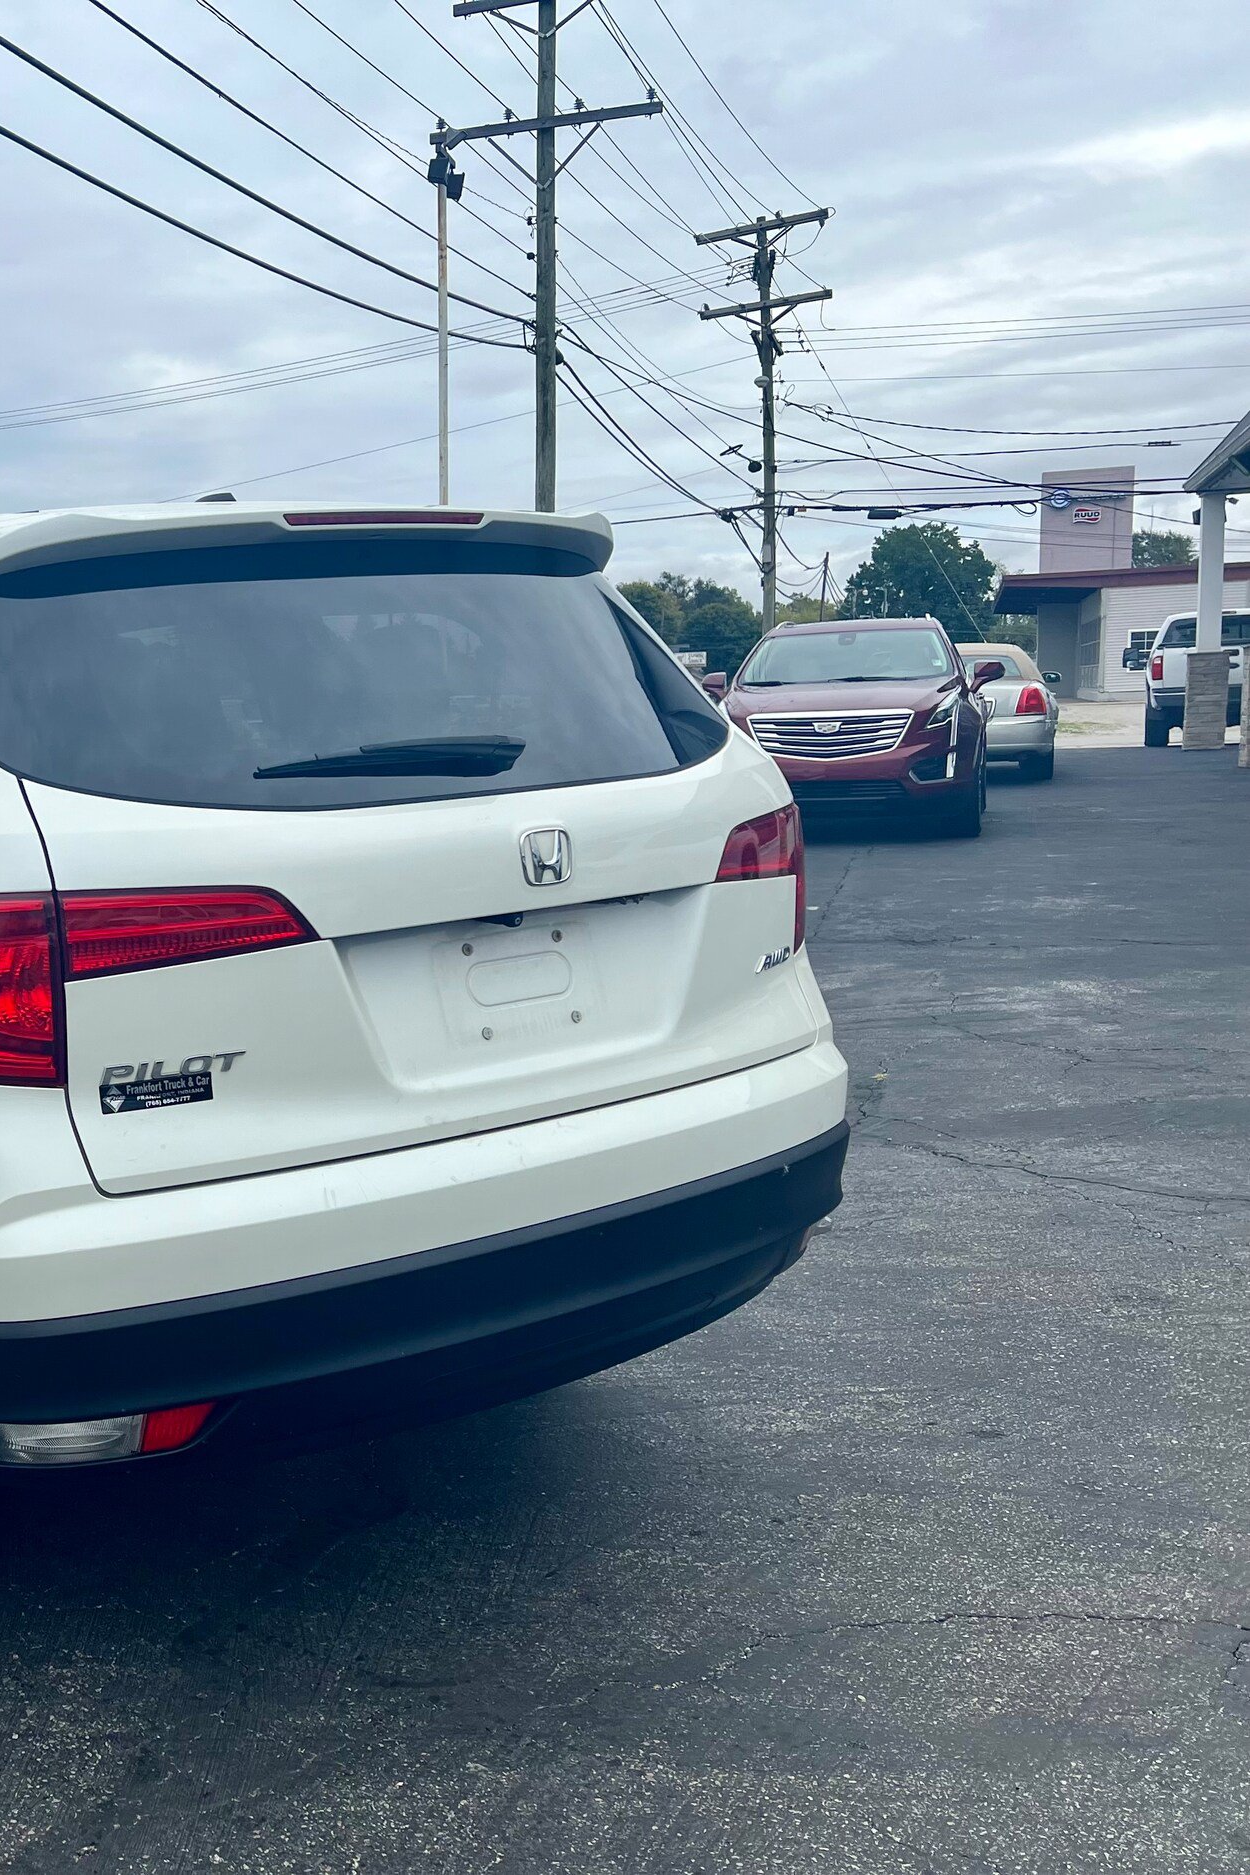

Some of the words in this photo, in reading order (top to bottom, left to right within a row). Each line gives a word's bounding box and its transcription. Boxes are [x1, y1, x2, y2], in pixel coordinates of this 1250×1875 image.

[756, 945, 790, 974] AWD
[101, 1050, 247, 1086] PILOT
[126, 1083, 162, 1095] Frankfort
[163, 1079, 186, 1090] Truck
[187, 1076, 194, 1087] &
[195, 1075, 210, 1086] Car
